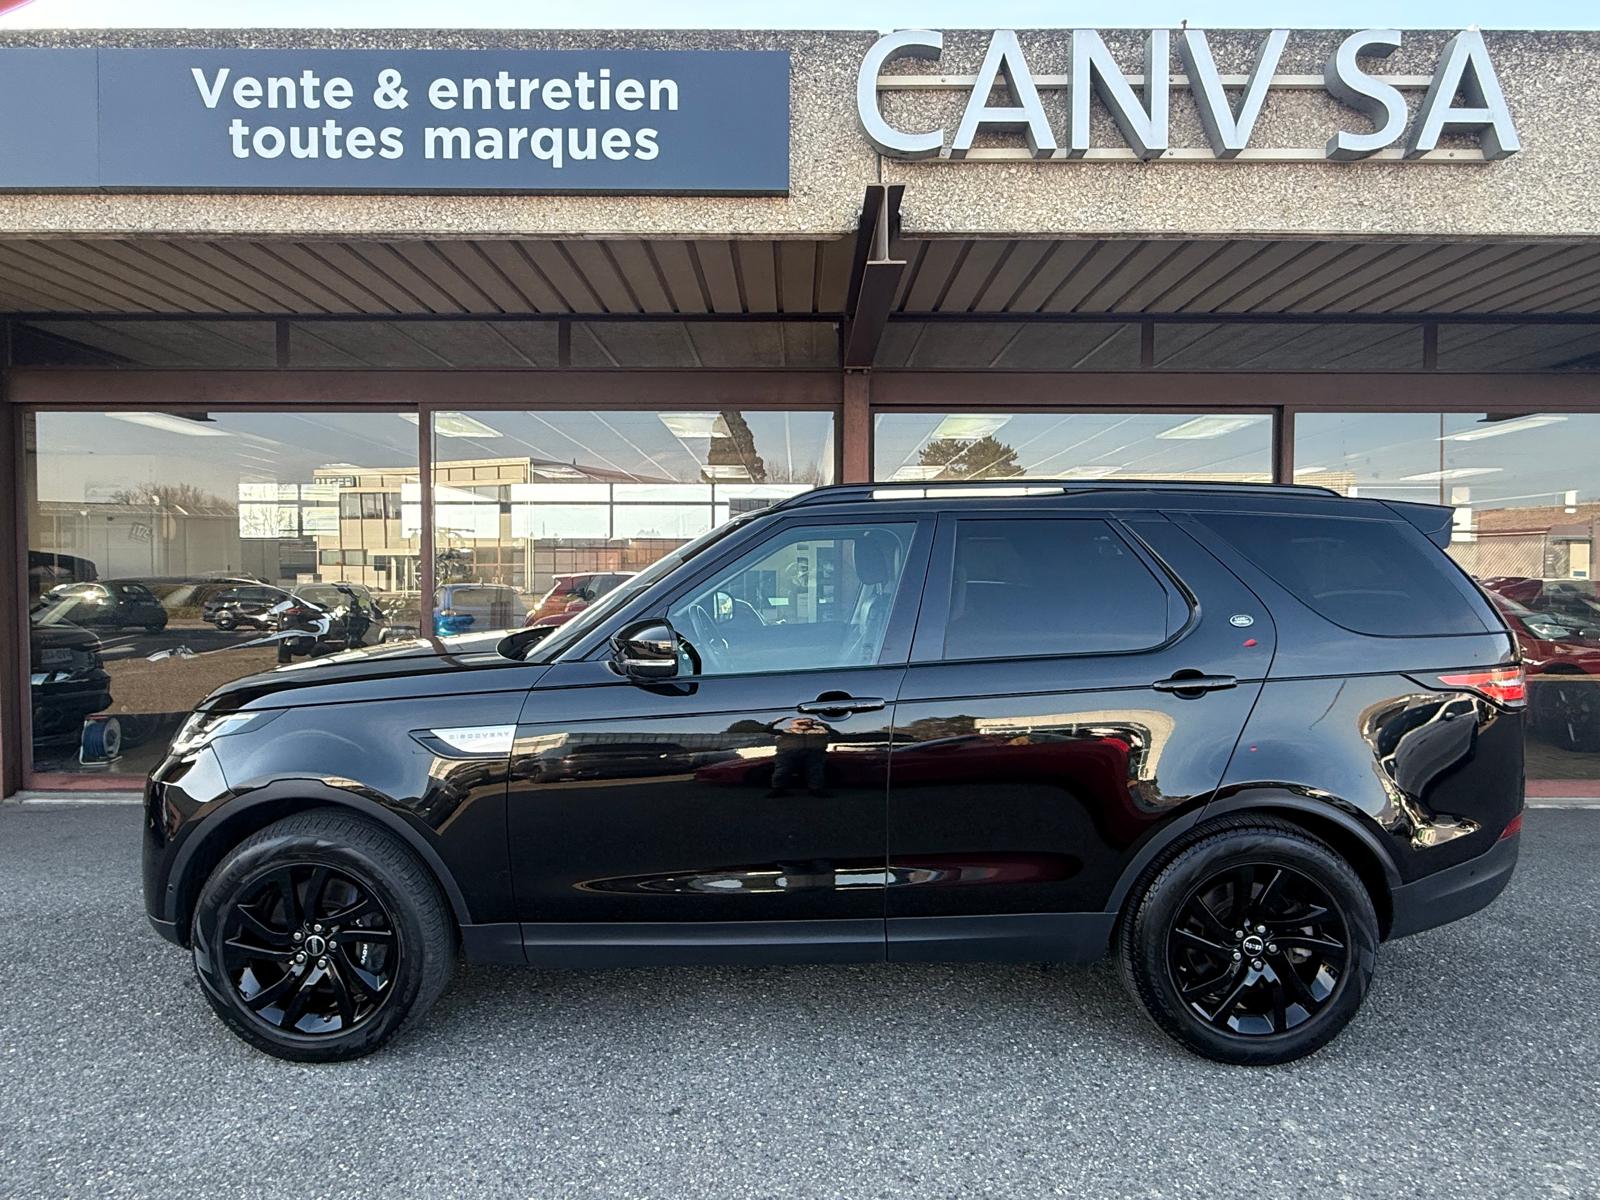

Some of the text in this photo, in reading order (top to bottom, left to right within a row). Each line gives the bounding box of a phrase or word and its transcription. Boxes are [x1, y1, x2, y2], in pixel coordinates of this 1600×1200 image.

[191, 68, 679, 111] Vente & entretien
[856, 28, 1521, 158] CANV SA
[228, 119, 660, 168] toutes marques
